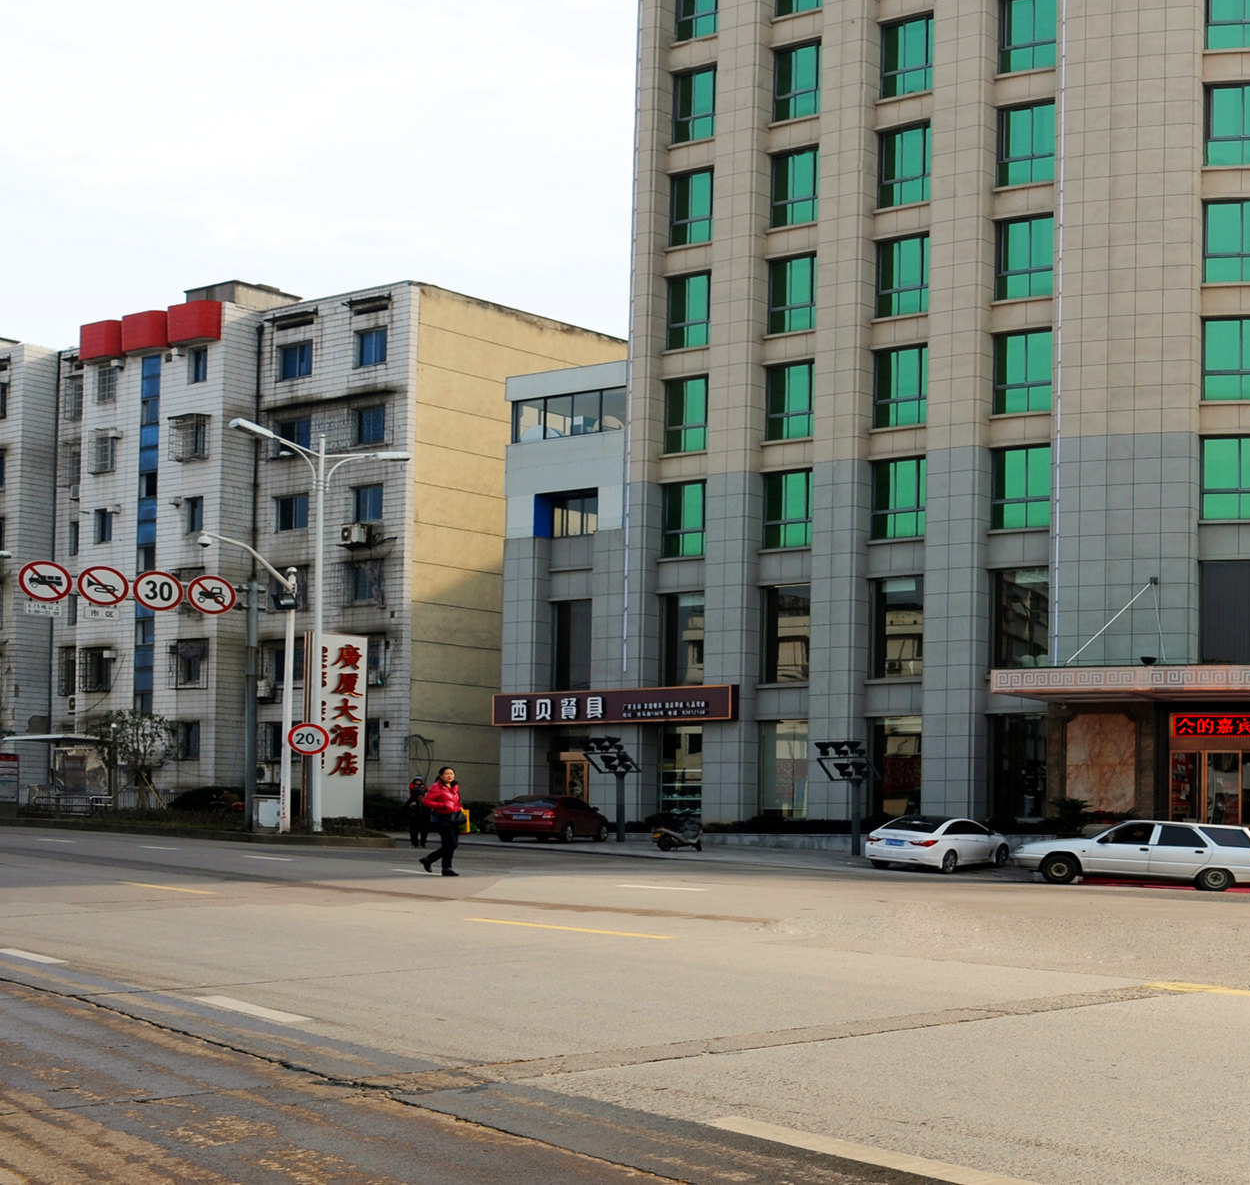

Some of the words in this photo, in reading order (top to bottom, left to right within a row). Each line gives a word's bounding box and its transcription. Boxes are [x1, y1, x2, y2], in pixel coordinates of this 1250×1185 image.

[144, 580, 173, 602] 30
[511, 696, 604, 721] 西贝餐具
